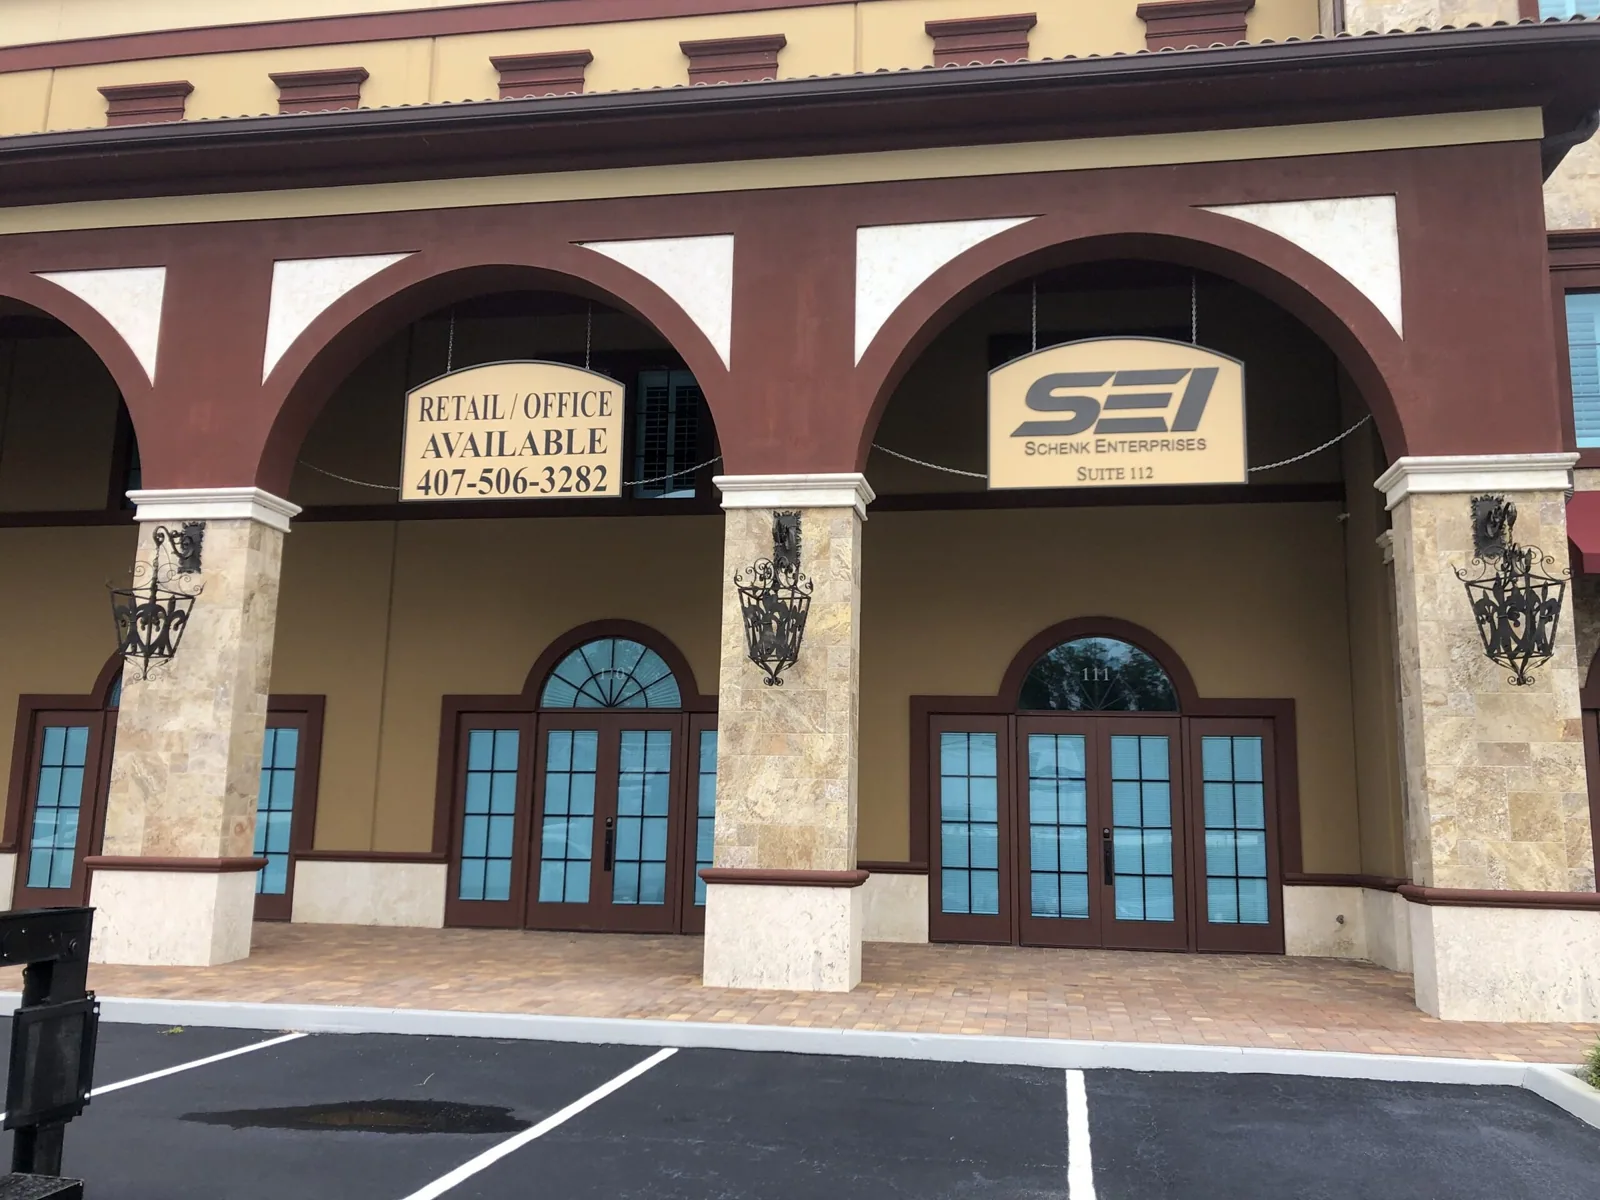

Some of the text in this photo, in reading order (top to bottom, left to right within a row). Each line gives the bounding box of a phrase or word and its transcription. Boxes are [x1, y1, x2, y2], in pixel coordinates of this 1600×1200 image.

[1009, 366, 1220, 438] SEI
[420, 427, 608, 459] AVAILABLE
[1024, 438, 1207, 456] SCHENK ENTERPRISES
[416, 464, 608, 496] 407-506-3282
[1076, 466, 1154, 481] SUITE 112
[1081, 667, 1111, 681] 111
